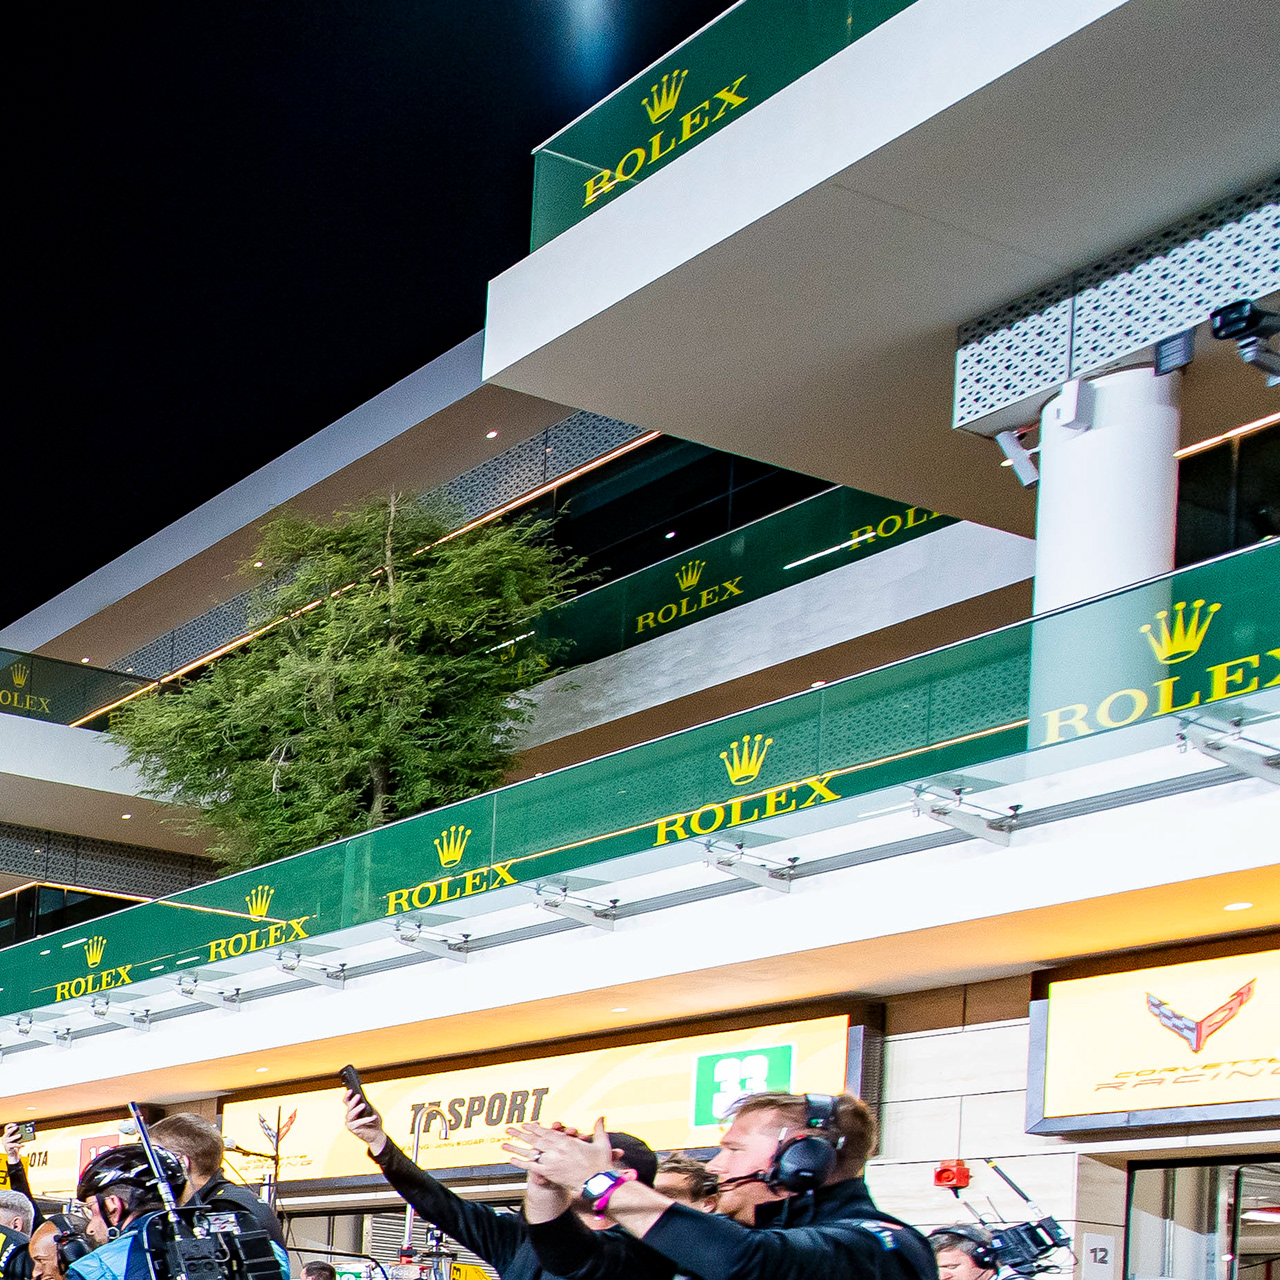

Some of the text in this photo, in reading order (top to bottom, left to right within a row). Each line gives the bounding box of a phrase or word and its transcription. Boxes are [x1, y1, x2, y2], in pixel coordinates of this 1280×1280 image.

[582, 74, 749, 209] ROLEX
[849, 506, 940, 551] ROL
[636, 575, 745, 634] ROLEX
[1040, 648, 1280, 748] ROLE
[653, 771, 841, 848] ROLEX
[385, 860, 519, 917] ROLEX
[208, 916, 309, 963] ROLEX
[56, 964, 133, 1003] ROLEX
[448, 1087, 549, 1131] SPORT
[712, 1055, 769, 1118] 33
[27, 1150, 49, 1168] OTA
[1090, 1247, 1109, 1265] 12
